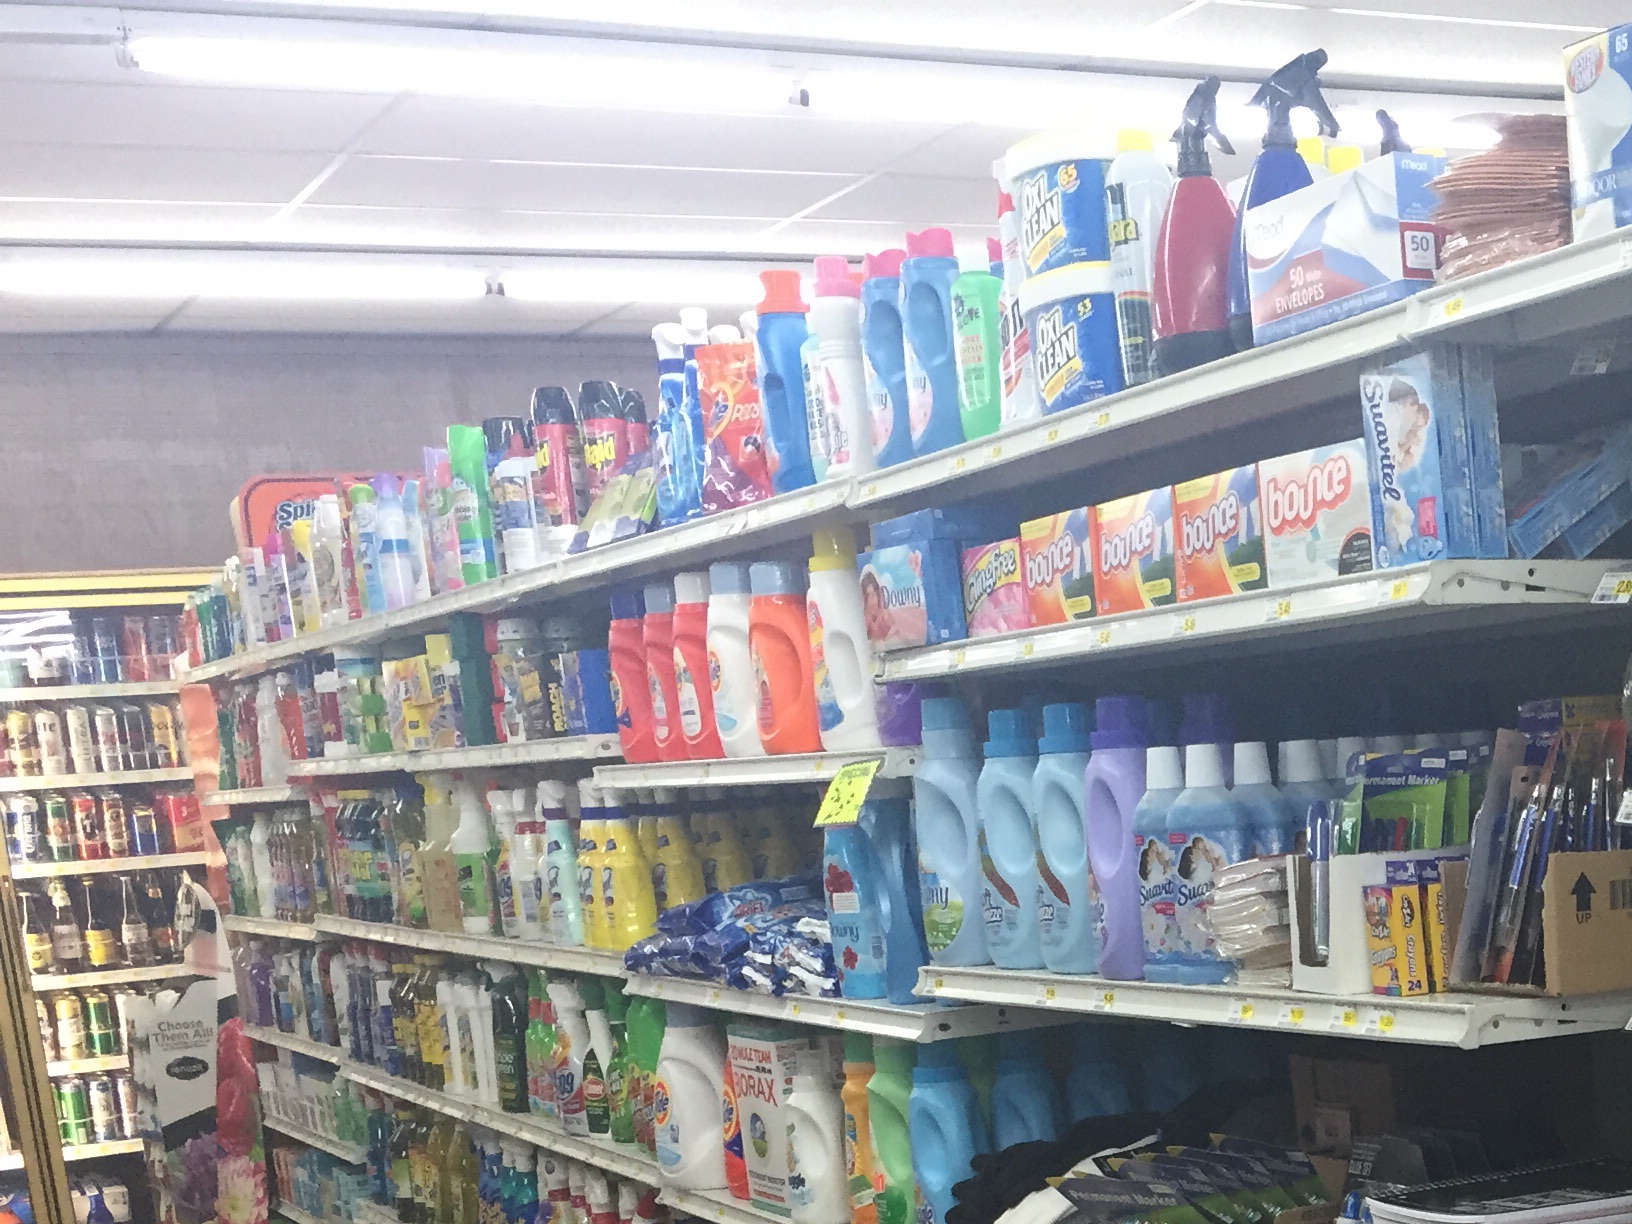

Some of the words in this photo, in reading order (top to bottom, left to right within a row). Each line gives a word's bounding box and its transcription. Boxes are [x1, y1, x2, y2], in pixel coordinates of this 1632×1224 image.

[1411, 235, 1429, 252] 50
[1275, 283, 1325, 314] ENVELOPES
[1290, 266, 1306, 289] 50
[1362, 377, 1402, 502] Suavitel
[1269, 456, 1350, 529] bounce
[1102, 512, 1153, 572] bounce
[1182, 494, 1238, 554] bounce
[1026, 532, 1074, 589] bounce
[881, 585, 922, 608] Downy
[1575, 913, 1592, 925] UP
